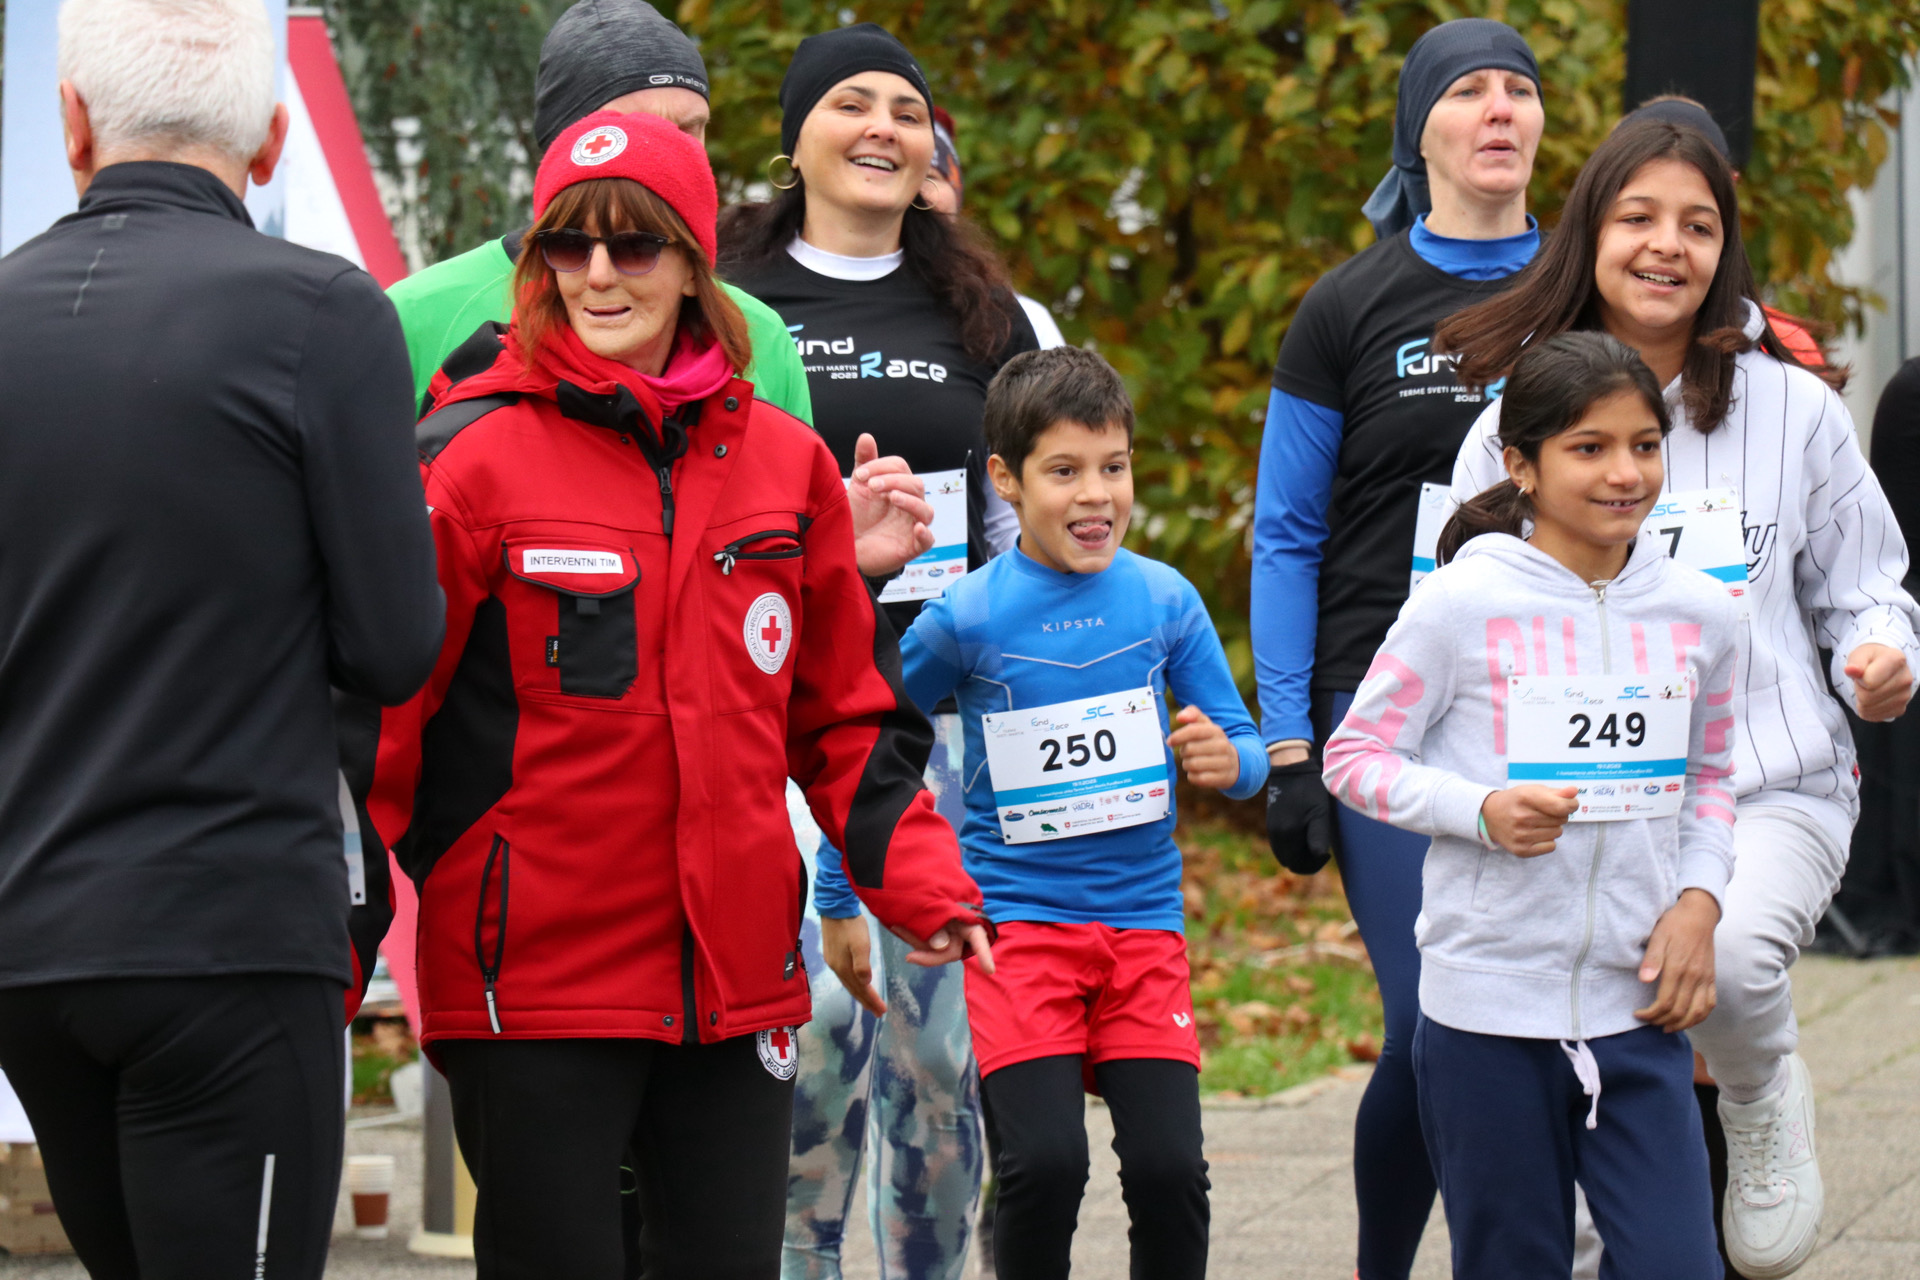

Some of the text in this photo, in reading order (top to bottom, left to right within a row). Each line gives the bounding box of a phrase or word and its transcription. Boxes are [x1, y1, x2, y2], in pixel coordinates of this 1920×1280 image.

[860, 351, 948, 383] Race
[830, 372, 859, 380] 2023
[1399, 387, 1426, 398] TERME
[1427, 386, 1449, 395] SVETI
[530, 556, 617, 567] INTERVENTNI TIM
[1041, 617, 1105, 633] KIPSTA
[1617, 686, 1650, 699] SC
[1082, 705, 1114, 721] SC
[1568, 711, 1646, 748] 249
[1039, 729, 1117, 773] 250
